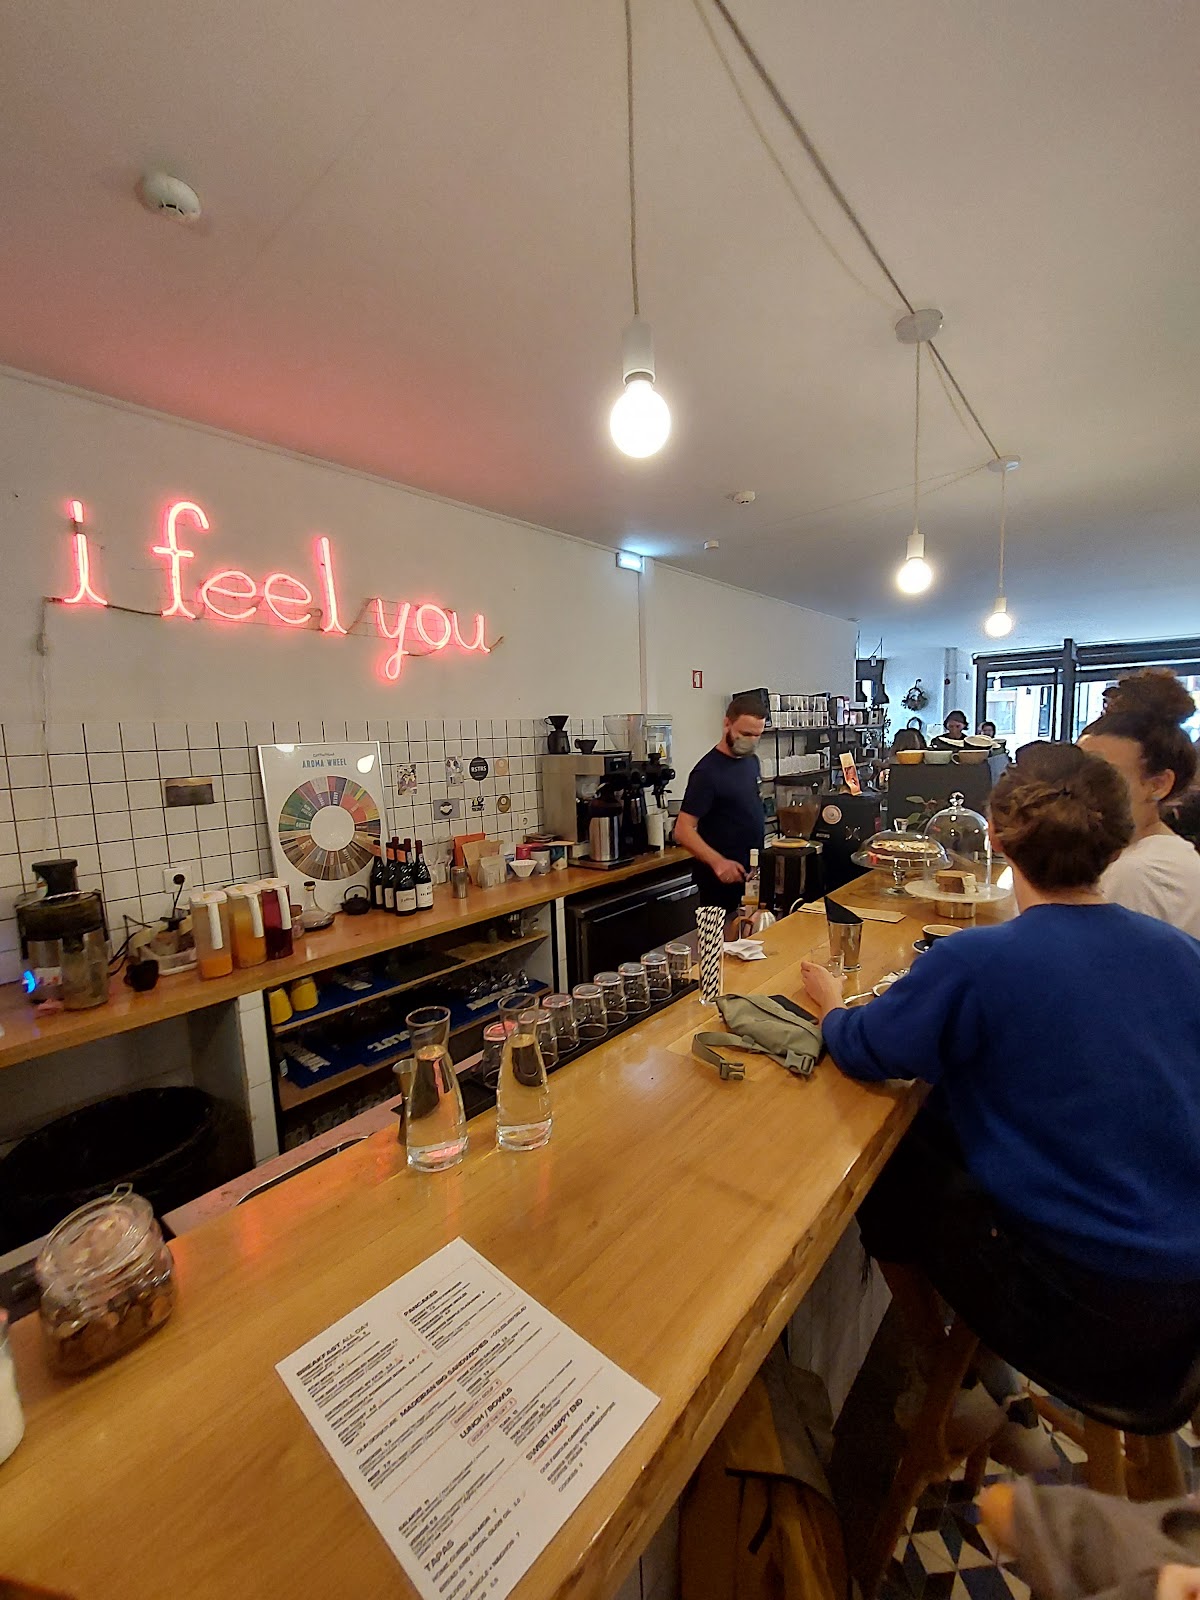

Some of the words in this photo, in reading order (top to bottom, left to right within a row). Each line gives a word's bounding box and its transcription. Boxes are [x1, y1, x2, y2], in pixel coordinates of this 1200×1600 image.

[63, 499, 109, 606] i
[152, 500, 348, 634] feel
[373, 597, 491, 681] you
[302, 759, 325, 768] AROMA
[327, 758, 347, 766] WHEEL
[404, 1290, 438, 1317] PANCAKES
[296, 1342, 340, 1377] BREAKFAST
[342, 1334, 355, 1344] ALL
[355, 1322, 368, 1334] DAY
[400, 1384, 436, 1417] MADEIRAN
[435, 1375, 448, 1386] BIG
[447, 1339, 489, 1375] SANDWICHES
[459, 1413, 484, 1439] LUNCH
[487, 1387, 513, 1412] BOWLS
[526, 1433, 550, 1460] SWEET
[549, 1411, 570, 1435] HAPPY
[569, 1398, 583, 1413] END
[550, 1442, 569, 1463] FAMOUS
[567, 1422, 584, 1442] CARROT
[584, 1411, 595, 1424] CAKE
[558, 1468, 578, 1492] COOKIES
[424, 1539, 454, 1572] TAPAS
[432, 1562, 449, 1583] HOME
[449, 1541, 468, 1563] CURED
[468, 1516, 491, 1542] SALMON
[439, 1570, 458, 1593] BREAD
[459, 1556, 471, 1570] AND
[470, 1536, 488, 1557] LOCAL
[488, 1518, 503, 1536] OLIVE
